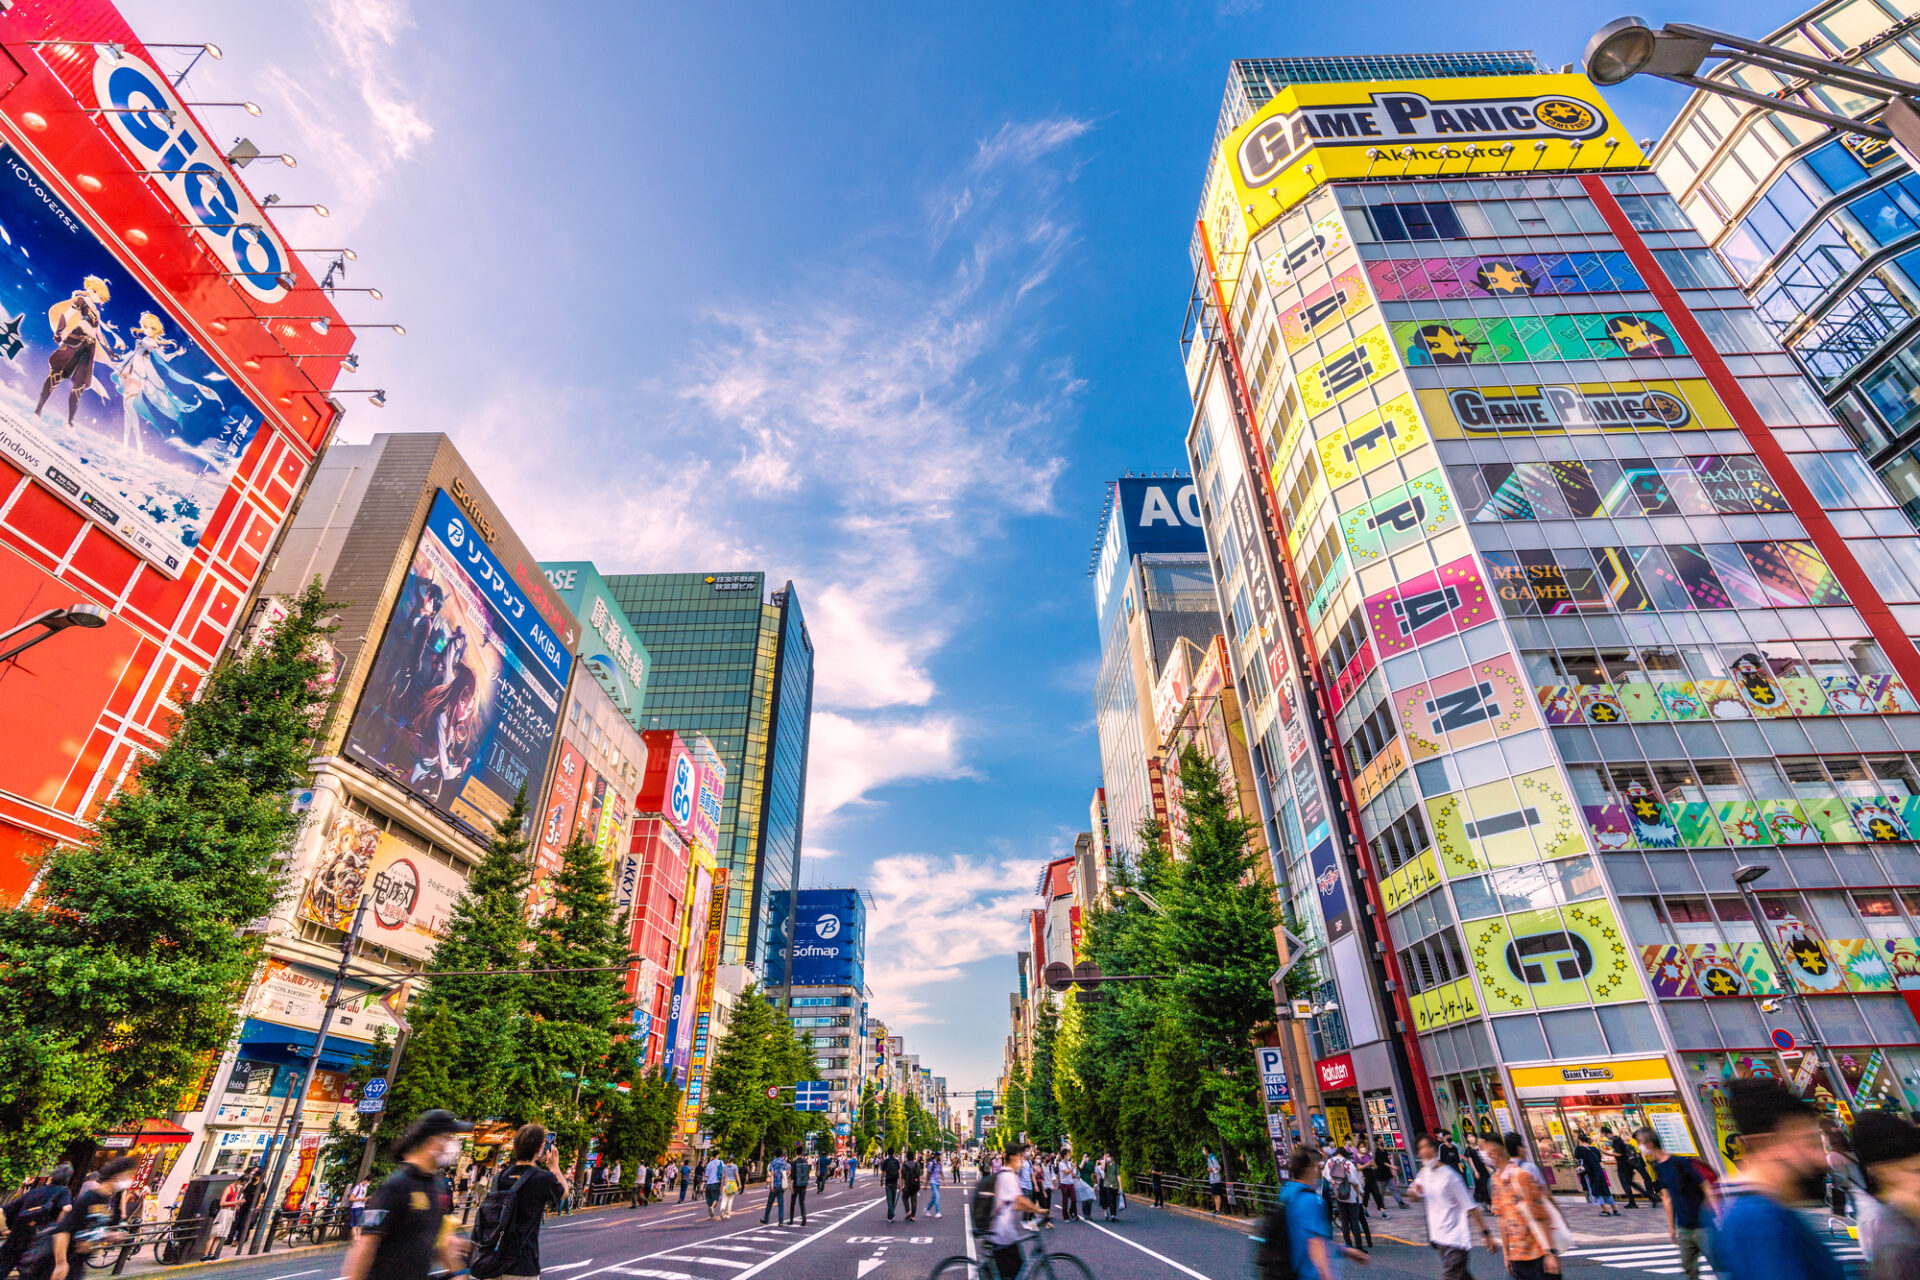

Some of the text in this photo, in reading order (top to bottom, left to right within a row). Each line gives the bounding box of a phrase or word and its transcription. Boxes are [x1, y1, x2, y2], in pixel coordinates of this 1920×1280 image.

[1244, 96, 1537, 176] GAME PANIC
[1374, 145, 1506, 163] Akihabara
[108, 66, 282, 292] GiGO
[6, 157, 79, 234] HOYOVERSE
[1454, 390, 1648, 427] GAME PANIC
[1687, 466, 1762, 484] DANCE
[1695, 485, 1763, 501] GAME
[451, 477, 497, 544] Sofmap
[467, 540, 525, 619] ソフマップ
[716, 575, 756, 584] 住友不動産
[1492, 564, 1569, 581] MUSIC
[516, 560, 567, 636] ビックカメラ
[715, 582, 756, 591] 秋葉原ビル
[1500, 583, 1571, 601] GAME
[530, 622, 562, 670] AKIBA
[561, 751, 576, 778] 4F
[673, 758, 690, 822] GiGO
[1360, 756, 1403, 802] クレーンゲーム
[545, 819, 561, 847] 3F
[622, 856, 637, 898] AKKY
[1388, 866, 1436, 907] クレーンゲーム
[792, 944, 840, 959] Sofmap
[671, 994, 681, 1020] GiGO
[1419, 999, 1475, 1028] クレーンゲーム
[1263, 1051, 1279, 1073] P
[1321, 1062, 1349, 1082] Rakuten
[1562, 1067, 1604, 1079] GAME PANIC
[229, 1080, 246, 1089] Hobby
[366, 1083, 387, 1093] 437
[1266, 1084, 1279, 1095] IN
[228, 1133, 240, 1144] 3F
